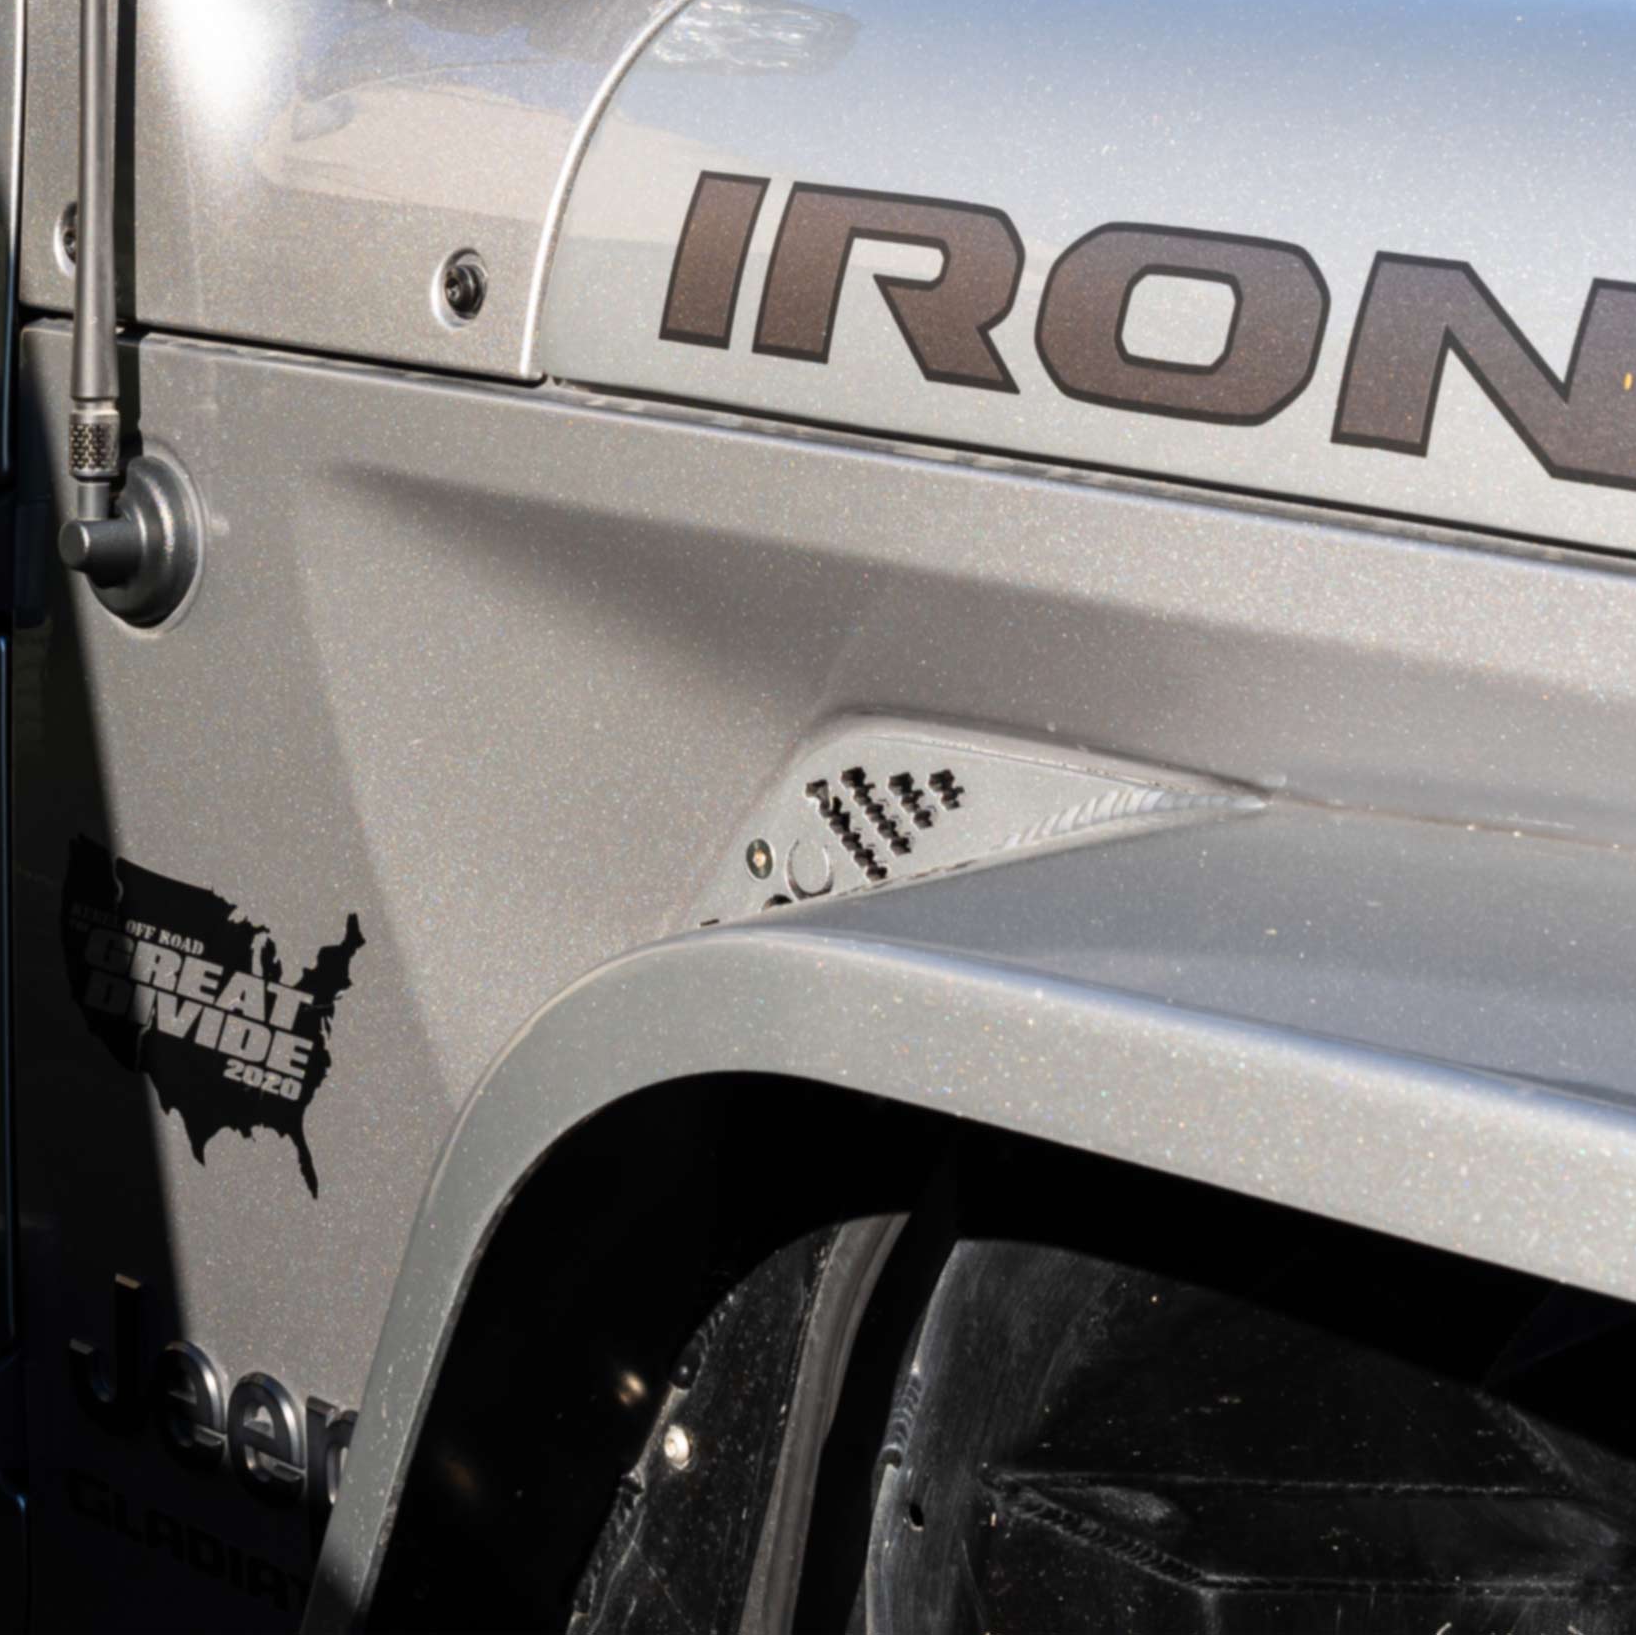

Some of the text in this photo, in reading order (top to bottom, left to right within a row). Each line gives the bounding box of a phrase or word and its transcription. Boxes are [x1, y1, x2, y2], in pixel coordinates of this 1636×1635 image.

[125, 919, 156, 940] OFF
[159, 929, 205, 956] ROAD
[85, 927, 315, 1031] GREAT
[83, 968, 315, 1080] DIVIDE
[222, 1059, 303, 1101] 2020
